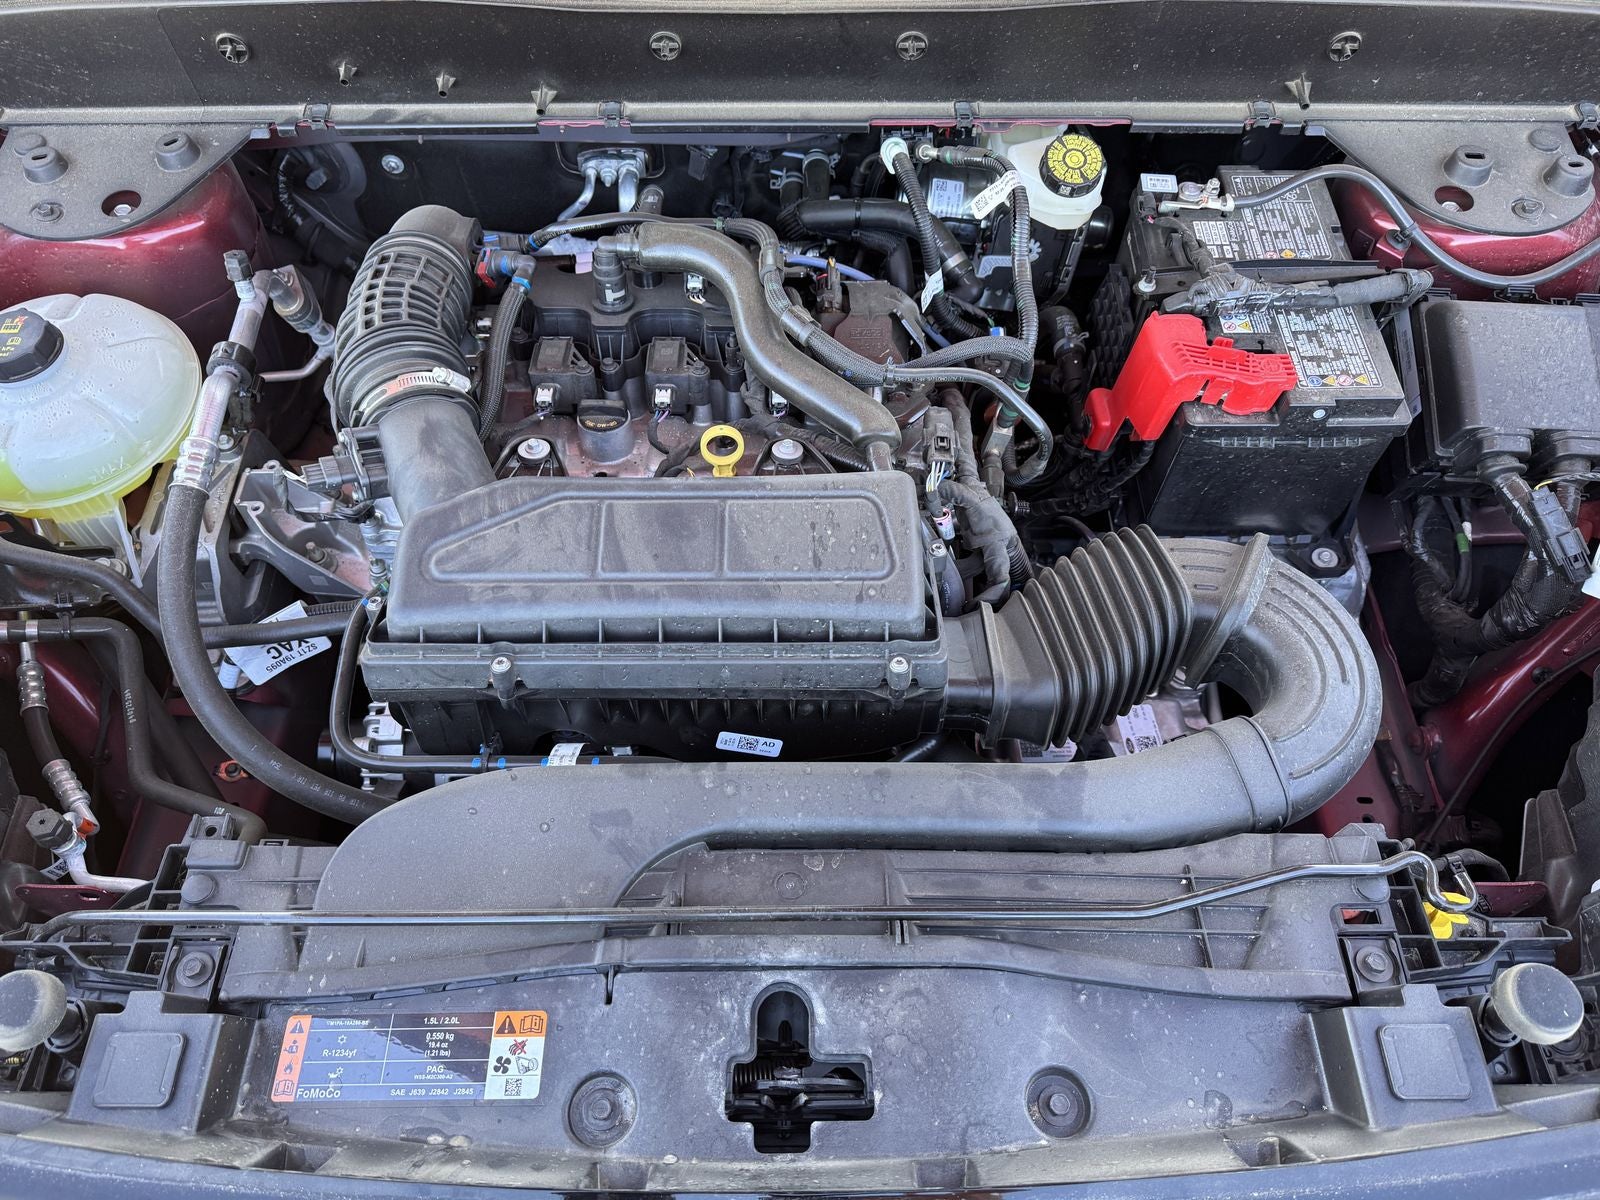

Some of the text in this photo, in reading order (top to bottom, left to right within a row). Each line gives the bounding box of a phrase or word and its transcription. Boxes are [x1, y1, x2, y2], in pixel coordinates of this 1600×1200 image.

[265, 642, 319, 673] SZ1T 19A095
[424, 1017, 439, 1025] 1.5L
[444, 1016, 460, 1024] 2.0L
[426, 1032, 455, 1041] 0.550 kg
[322, 1048, 357, 1058] R-1234yf
[426, 1065, 444, 1074] PAG
[296, 1088, 341, 1099] FoMoCo
[390, 1087, 474, 1096] SAE J639 J2842 J2845
